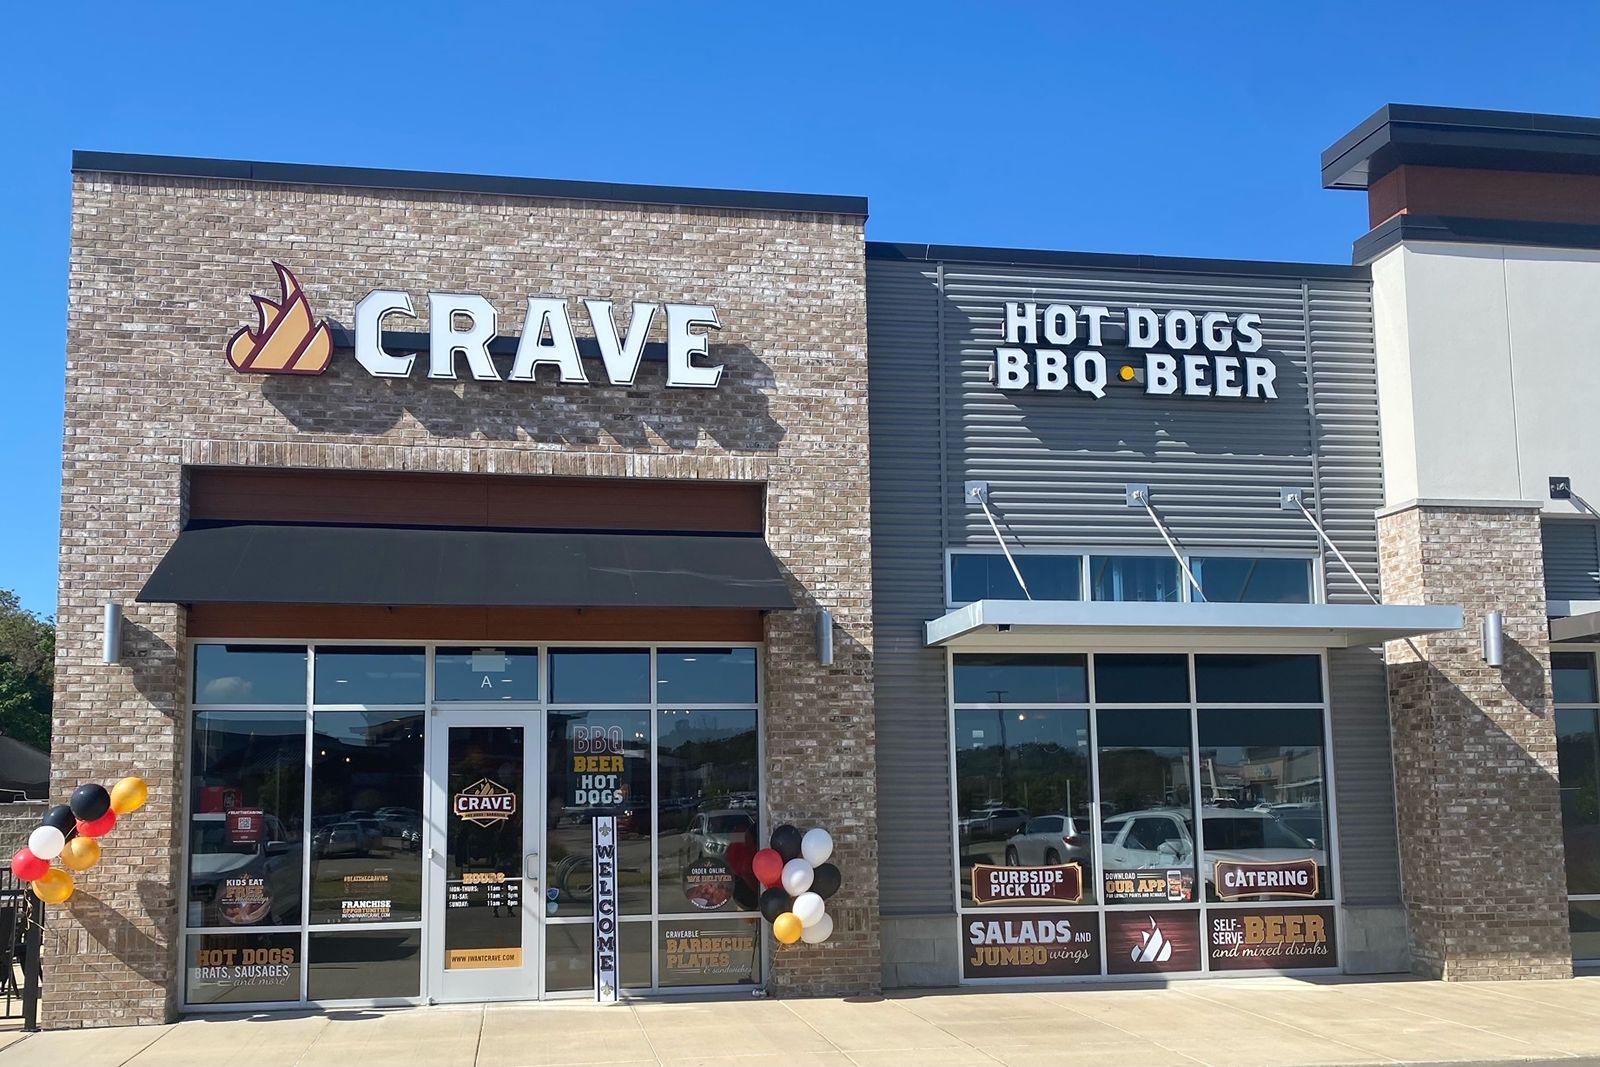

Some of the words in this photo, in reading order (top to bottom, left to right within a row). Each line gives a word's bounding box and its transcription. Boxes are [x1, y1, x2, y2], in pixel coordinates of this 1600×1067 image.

[1004, 301, 1110, 347] HOT
[1125, 307, 1263, 352] DOGS
[354, 289, 725, 388] CRAVE
[995, 347, 1107, 399] BBQ
[1145, 352, 1279, 399] BEER
[480, 675, 492, 688] A
[573, 725, 625, 755] BBQ
[573, 755, 625, 772] BEER
[581, 774, 618, 790] HOT
[458, 796, 512, 811] CRAVE
[575, 789, 624, 804] DOGS
[248, 878, 264, 886] EAT
[462, 872, 505, 884] HOURS
[989, 871, 1064, 884] CURBSIDE
[1105, 872, 1136, 880] DOWNLOAD
[1224, 869, 1308, 888] CATERING
[226, 885, 264, 898] FREE
[990, 884, 1026, 897] PICK
[1030, 884, 1051, 896] UP
[1105, 880, 1135, 893] OUR
[1137, 879, 1167, 892] APP
[341, 900, 391, 908] FRANCHISE
[596, 844, 615, 972] WELCOME
[969, 920, 1072, 945] SALADS
[1074, 932, 1092, 943] AND
[1212, 931, 1244, 945] SERVE
[1243, 914, 1327, 944] BEER
[1213, 918, 1242, 932] SELF-
[665, 930, 699, 938] CRAVEABLE
[666, 937, 753, 953] BARBECUE
[1212, 941, 1240, 958] and
[1242, 940, 1283, 957] mixed
[1285, 939, 1329, 956] drinks
[196, 949, 237, 966] HOT
[242, 947, 295, 965] DOGS
[666, 953, 730, 969] PLATES
[970, 946, 1048, 967] JUMBO
[1049, 946, 1090, 964] wings
[195, 966, 231, 979] BRATS,
[234, 964, 290, 978] SAUSAGES
[233, 973, 257, 987] and
